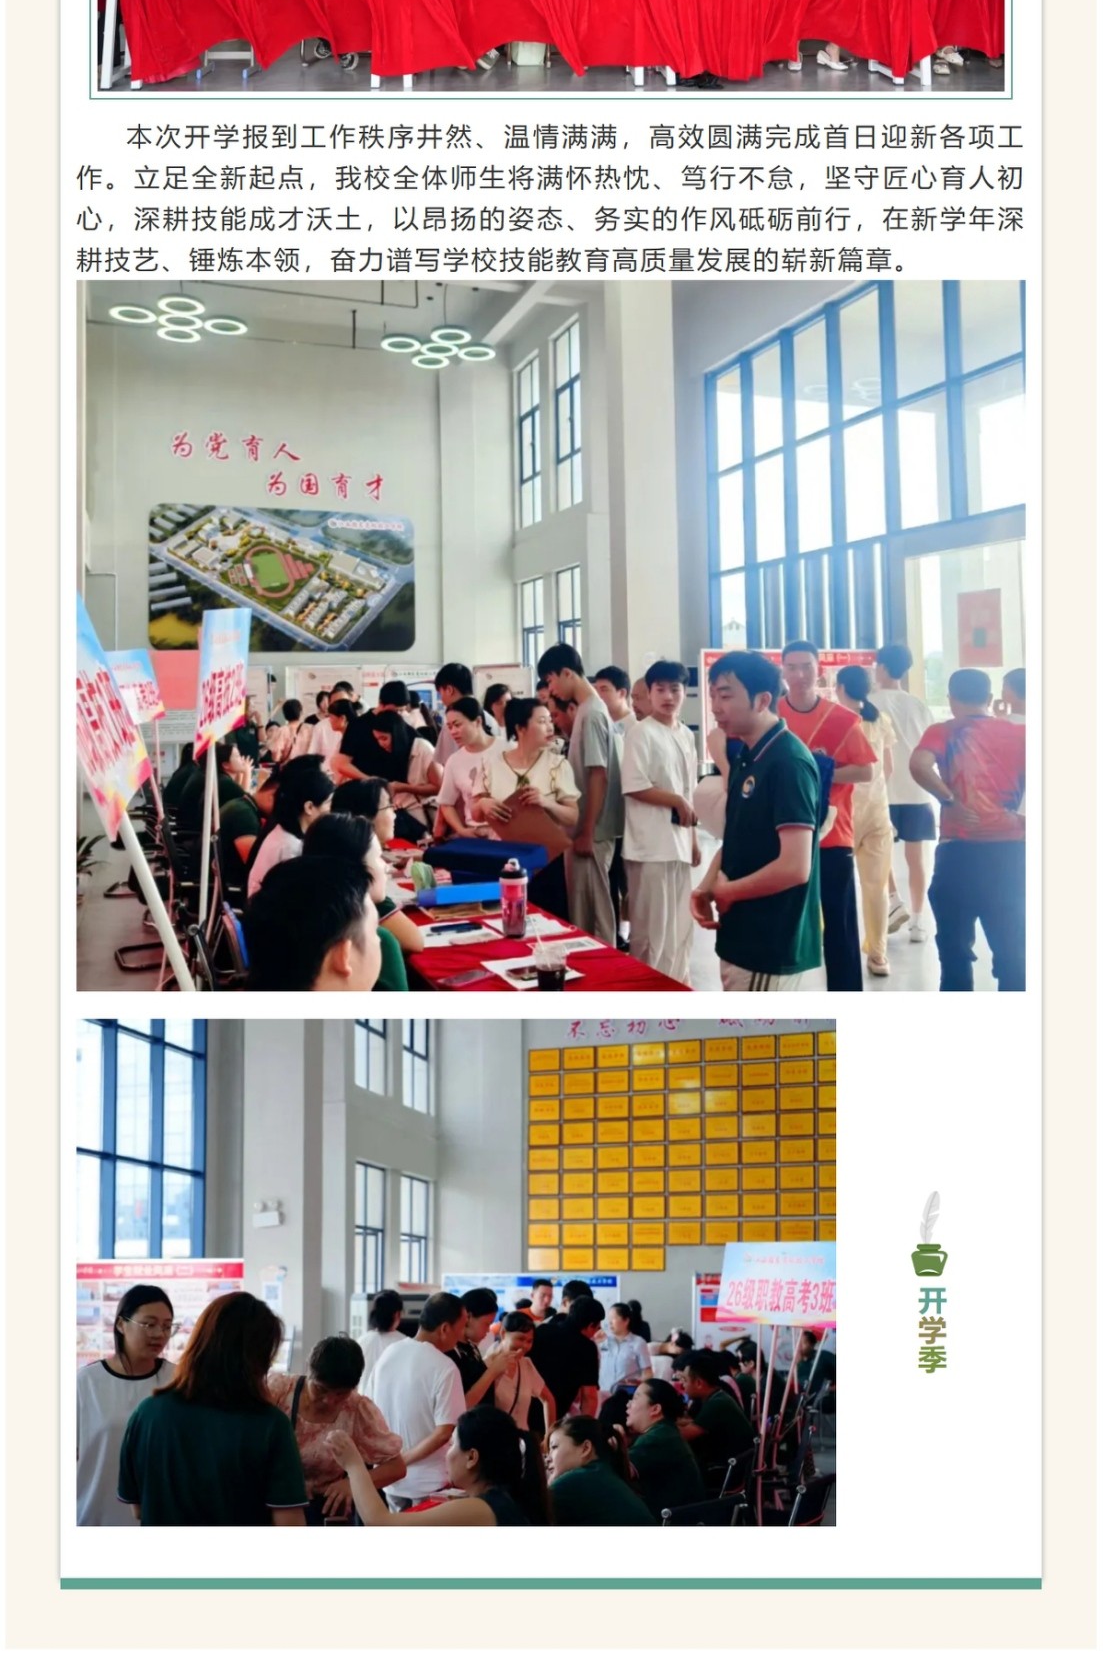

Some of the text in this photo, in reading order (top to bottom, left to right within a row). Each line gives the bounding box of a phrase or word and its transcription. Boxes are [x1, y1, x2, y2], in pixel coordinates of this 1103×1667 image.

[267, 471, 386, 501] 为国育才
[726, 1278, 834, 1314] 26级职教高考3班
